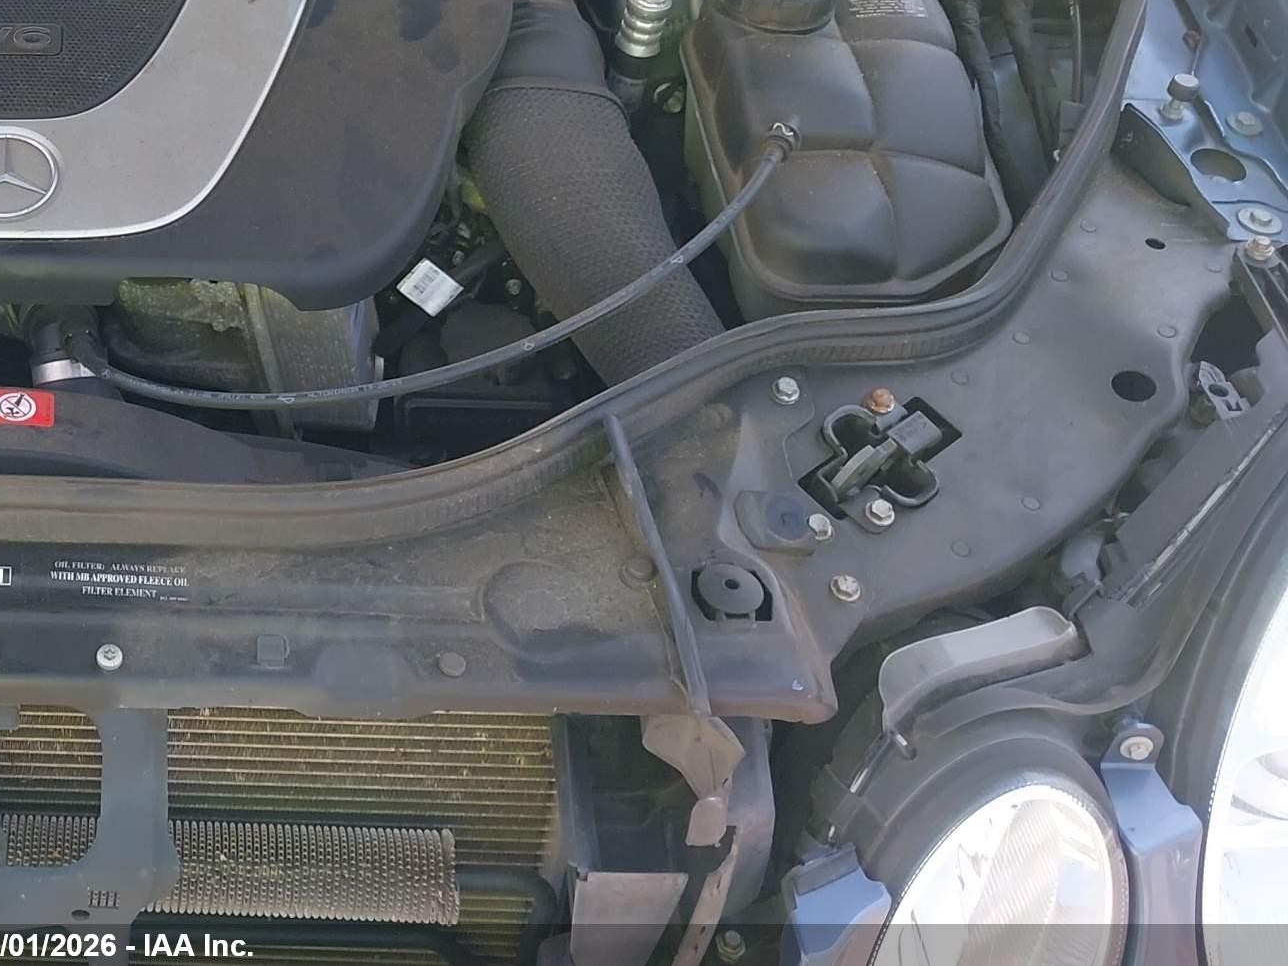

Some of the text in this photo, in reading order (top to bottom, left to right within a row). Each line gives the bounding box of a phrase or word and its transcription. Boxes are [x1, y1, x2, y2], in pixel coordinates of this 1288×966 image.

[54, 561, 70, 569] OIL
[110, 563, 145, 572] ALWAYS
[50, 571, 190, 587] WITH MB APPROVED FLEECE OIL
[82, 586, 158, 598] FILTER ELEMENT
